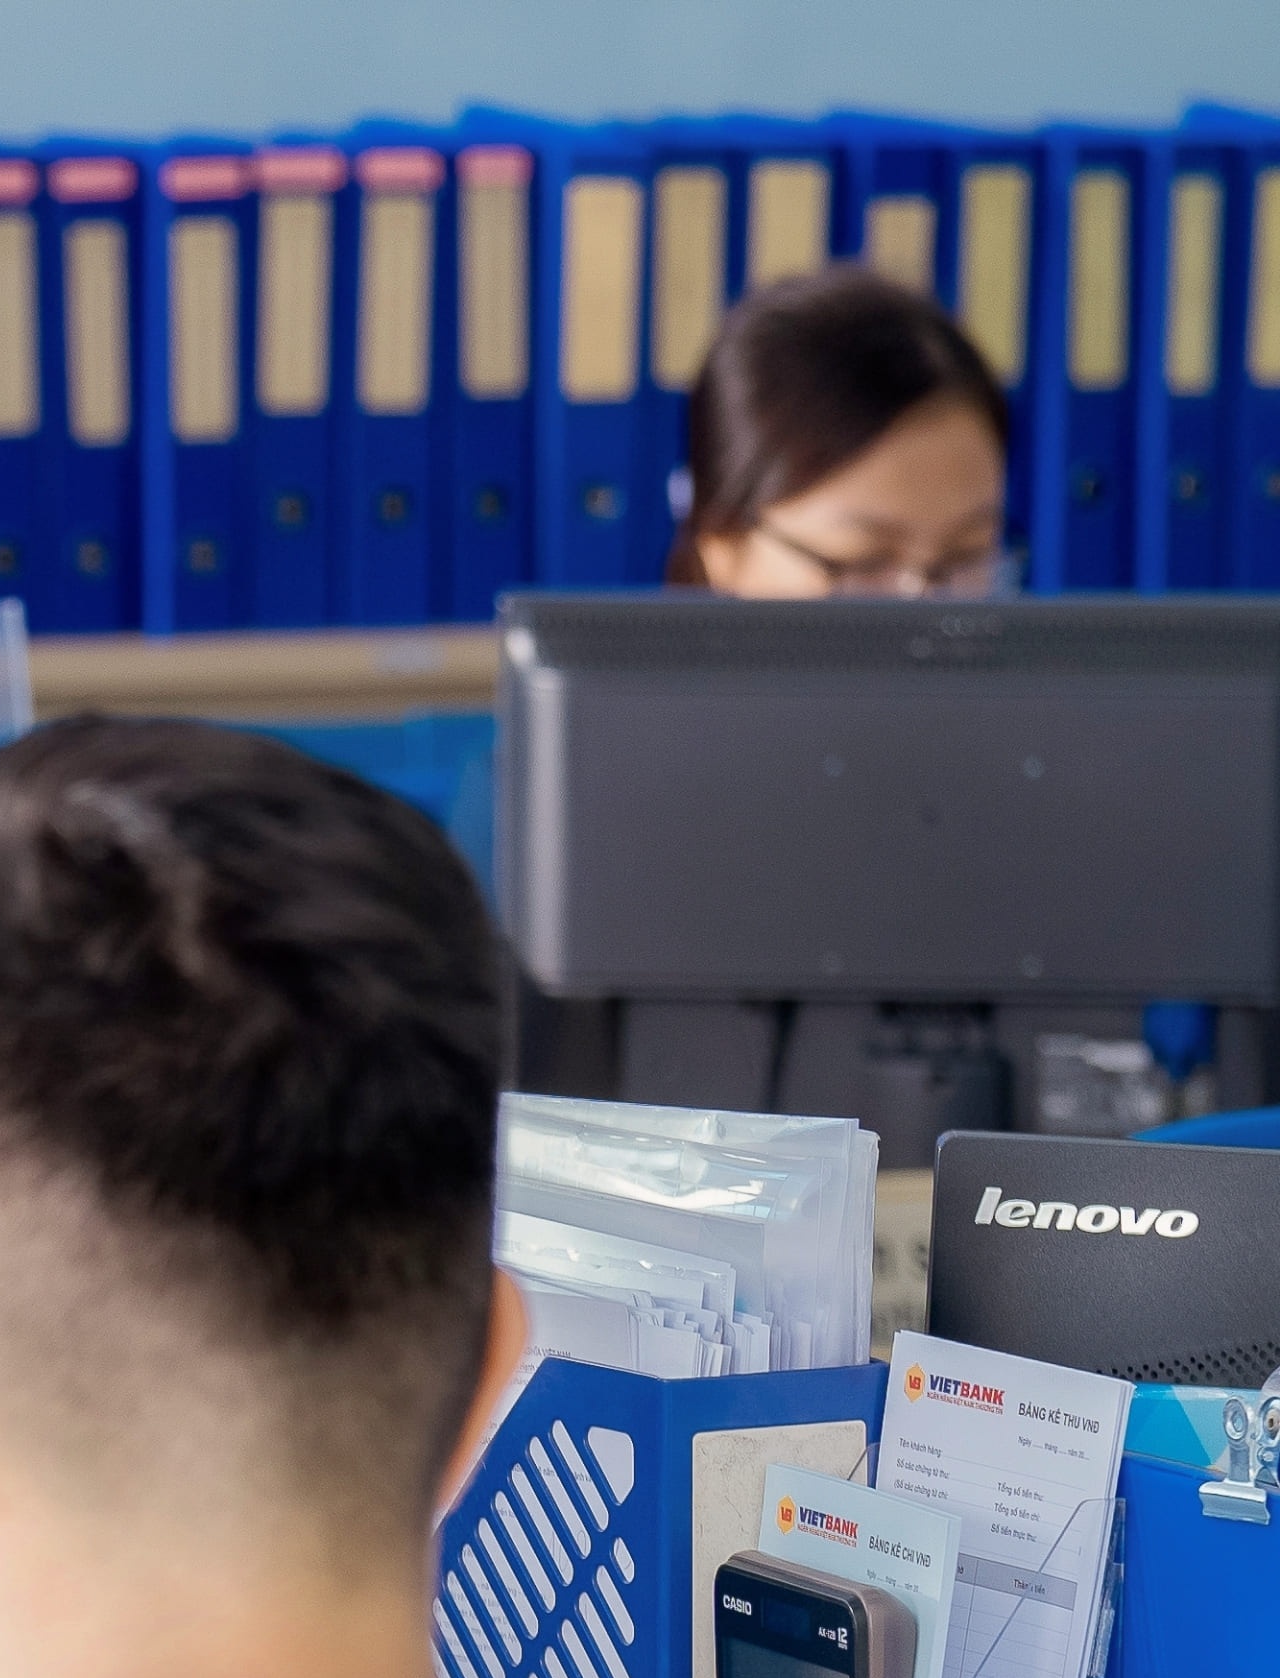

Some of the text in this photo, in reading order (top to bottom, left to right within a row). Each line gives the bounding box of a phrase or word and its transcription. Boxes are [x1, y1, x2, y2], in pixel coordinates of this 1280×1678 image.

[974, 1187, 1199, 1238] lenovo
[930, 1374, 1005, 1406] VIETBANK
[1063, 1412, 1081, 1429] THU
[1082, 1417, 1100, 1434] VNĐ
[799, 1505, 858, 1539] VIETBANK
[902, 1547, 915, 1563] CHI
[916, 1551, 931, 1568] VNĐ
[722, 1594, 752, 1616] CASIO
